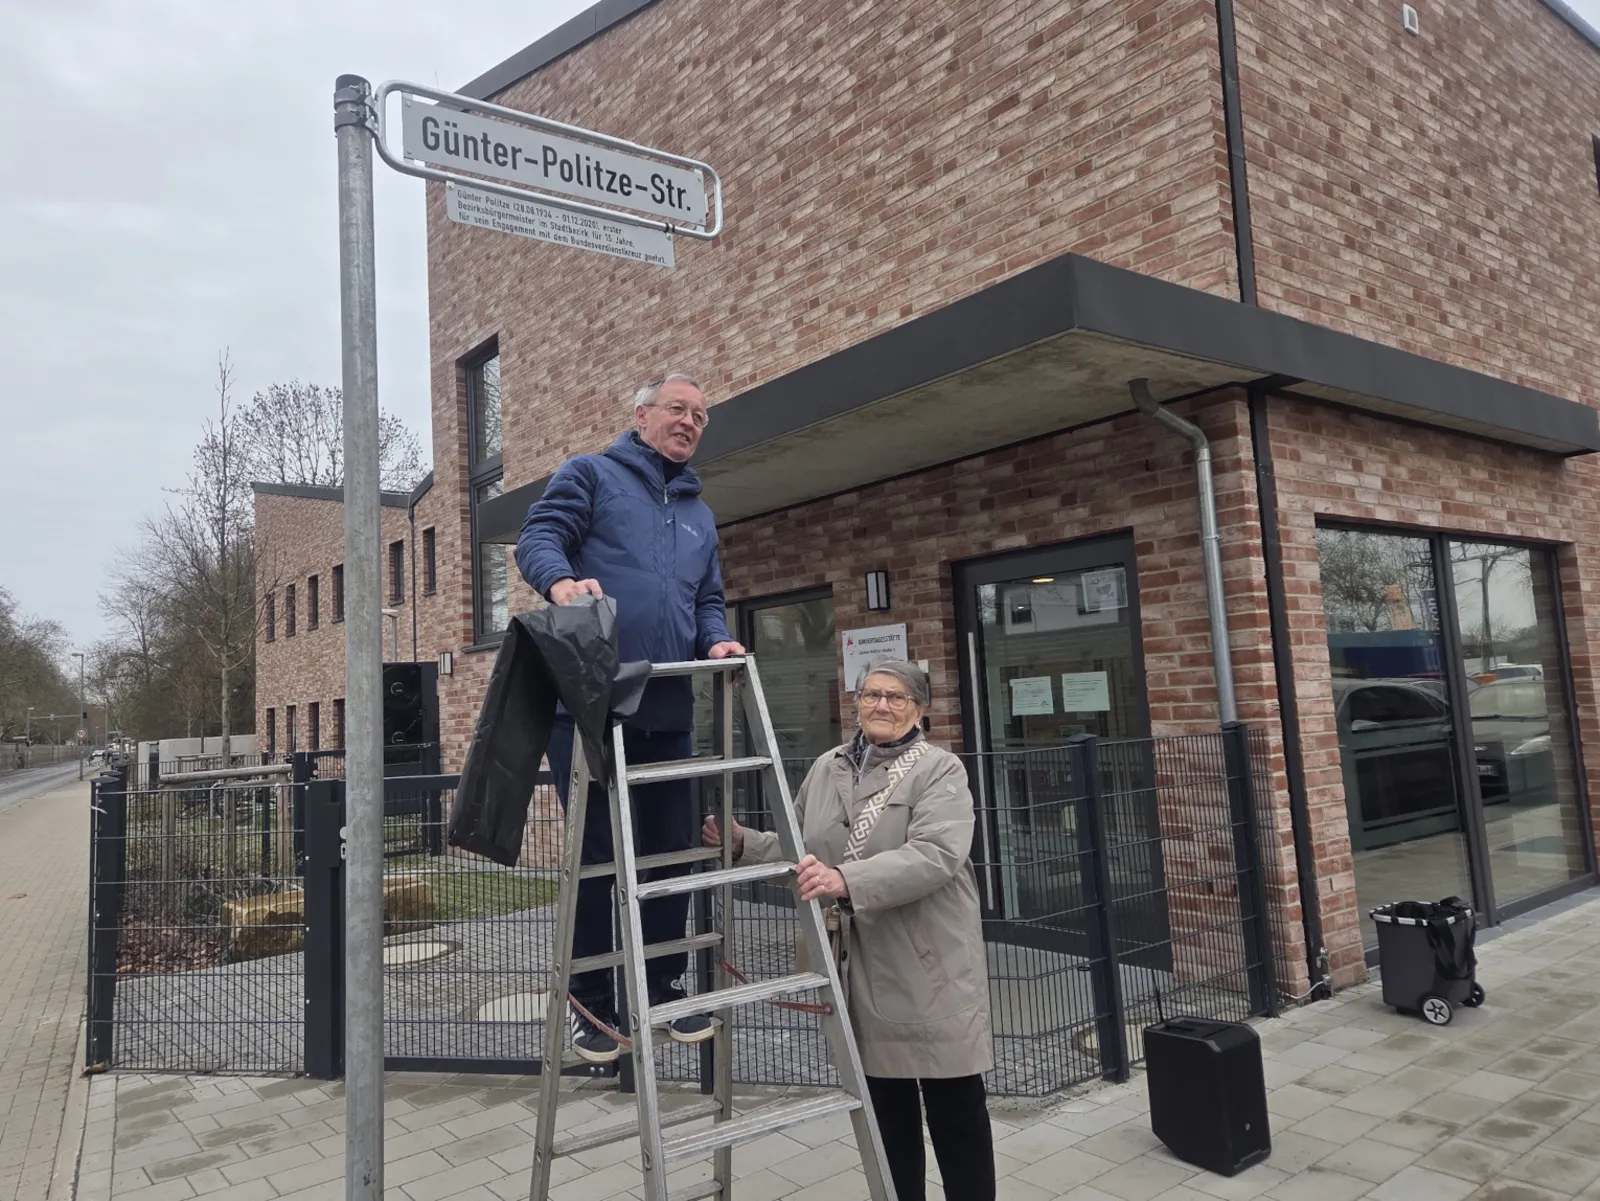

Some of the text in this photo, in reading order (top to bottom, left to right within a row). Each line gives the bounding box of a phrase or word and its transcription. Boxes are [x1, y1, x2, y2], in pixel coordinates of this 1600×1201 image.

[421, 115, 692, 211] Günter-Politze-Str.
[457, 190, 482, 202] Günter
[485, 196, 510, 209] Politze
[458, 201, 536, 224] Bezirksbürgermeister
[538, 220, 548, 228] im
[550, 222, 589, 237] Stadtbezirk
[592, 230, 602, 240] für
[459, 212, 470, 221] für
[475, 217, 490, 225] sein
[492, 219, 536, 235] Engagement
[538, 231, 551, 239] mit
[554, 234, 569, 243] dem
[571, 236, 642, 258] Bundesverdienstkreuz
